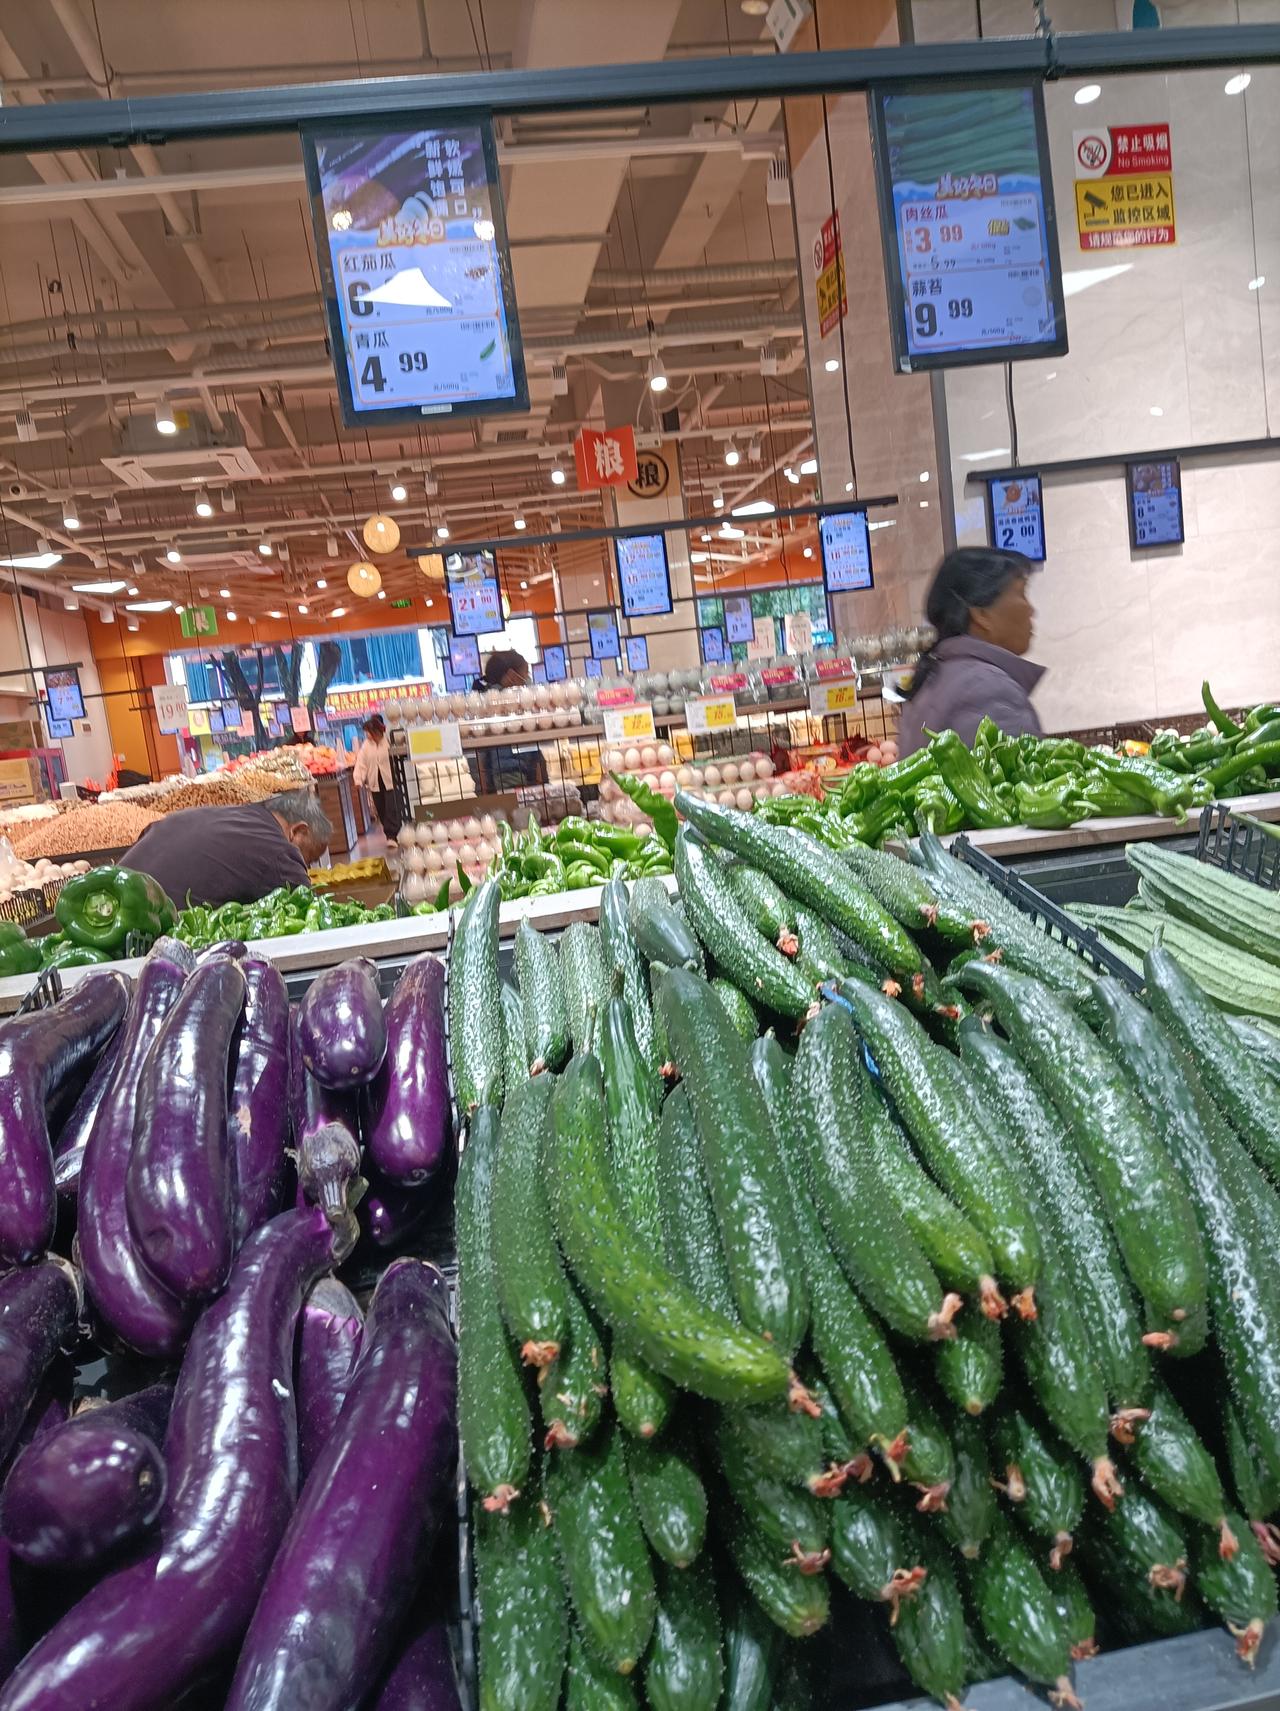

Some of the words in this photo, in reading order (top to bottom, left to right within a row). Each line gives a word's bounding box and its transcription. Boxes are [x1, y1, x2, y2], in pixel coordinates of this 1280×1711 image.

[1117, 133, 1168, 154] 禁止吸烟
[1118, 157, 1130, 168] No
[1131, 154, 1169, 167] Smoking
[1111, 182, 1169, 202] 您已进入
[905, 204, 948, 222] 肉丝瓜
[1113, 204, 1171, 224] 监控区域
[344, 253, 397, 273] 红茄瓜
[355, 331, 390, 349] 青瓜
